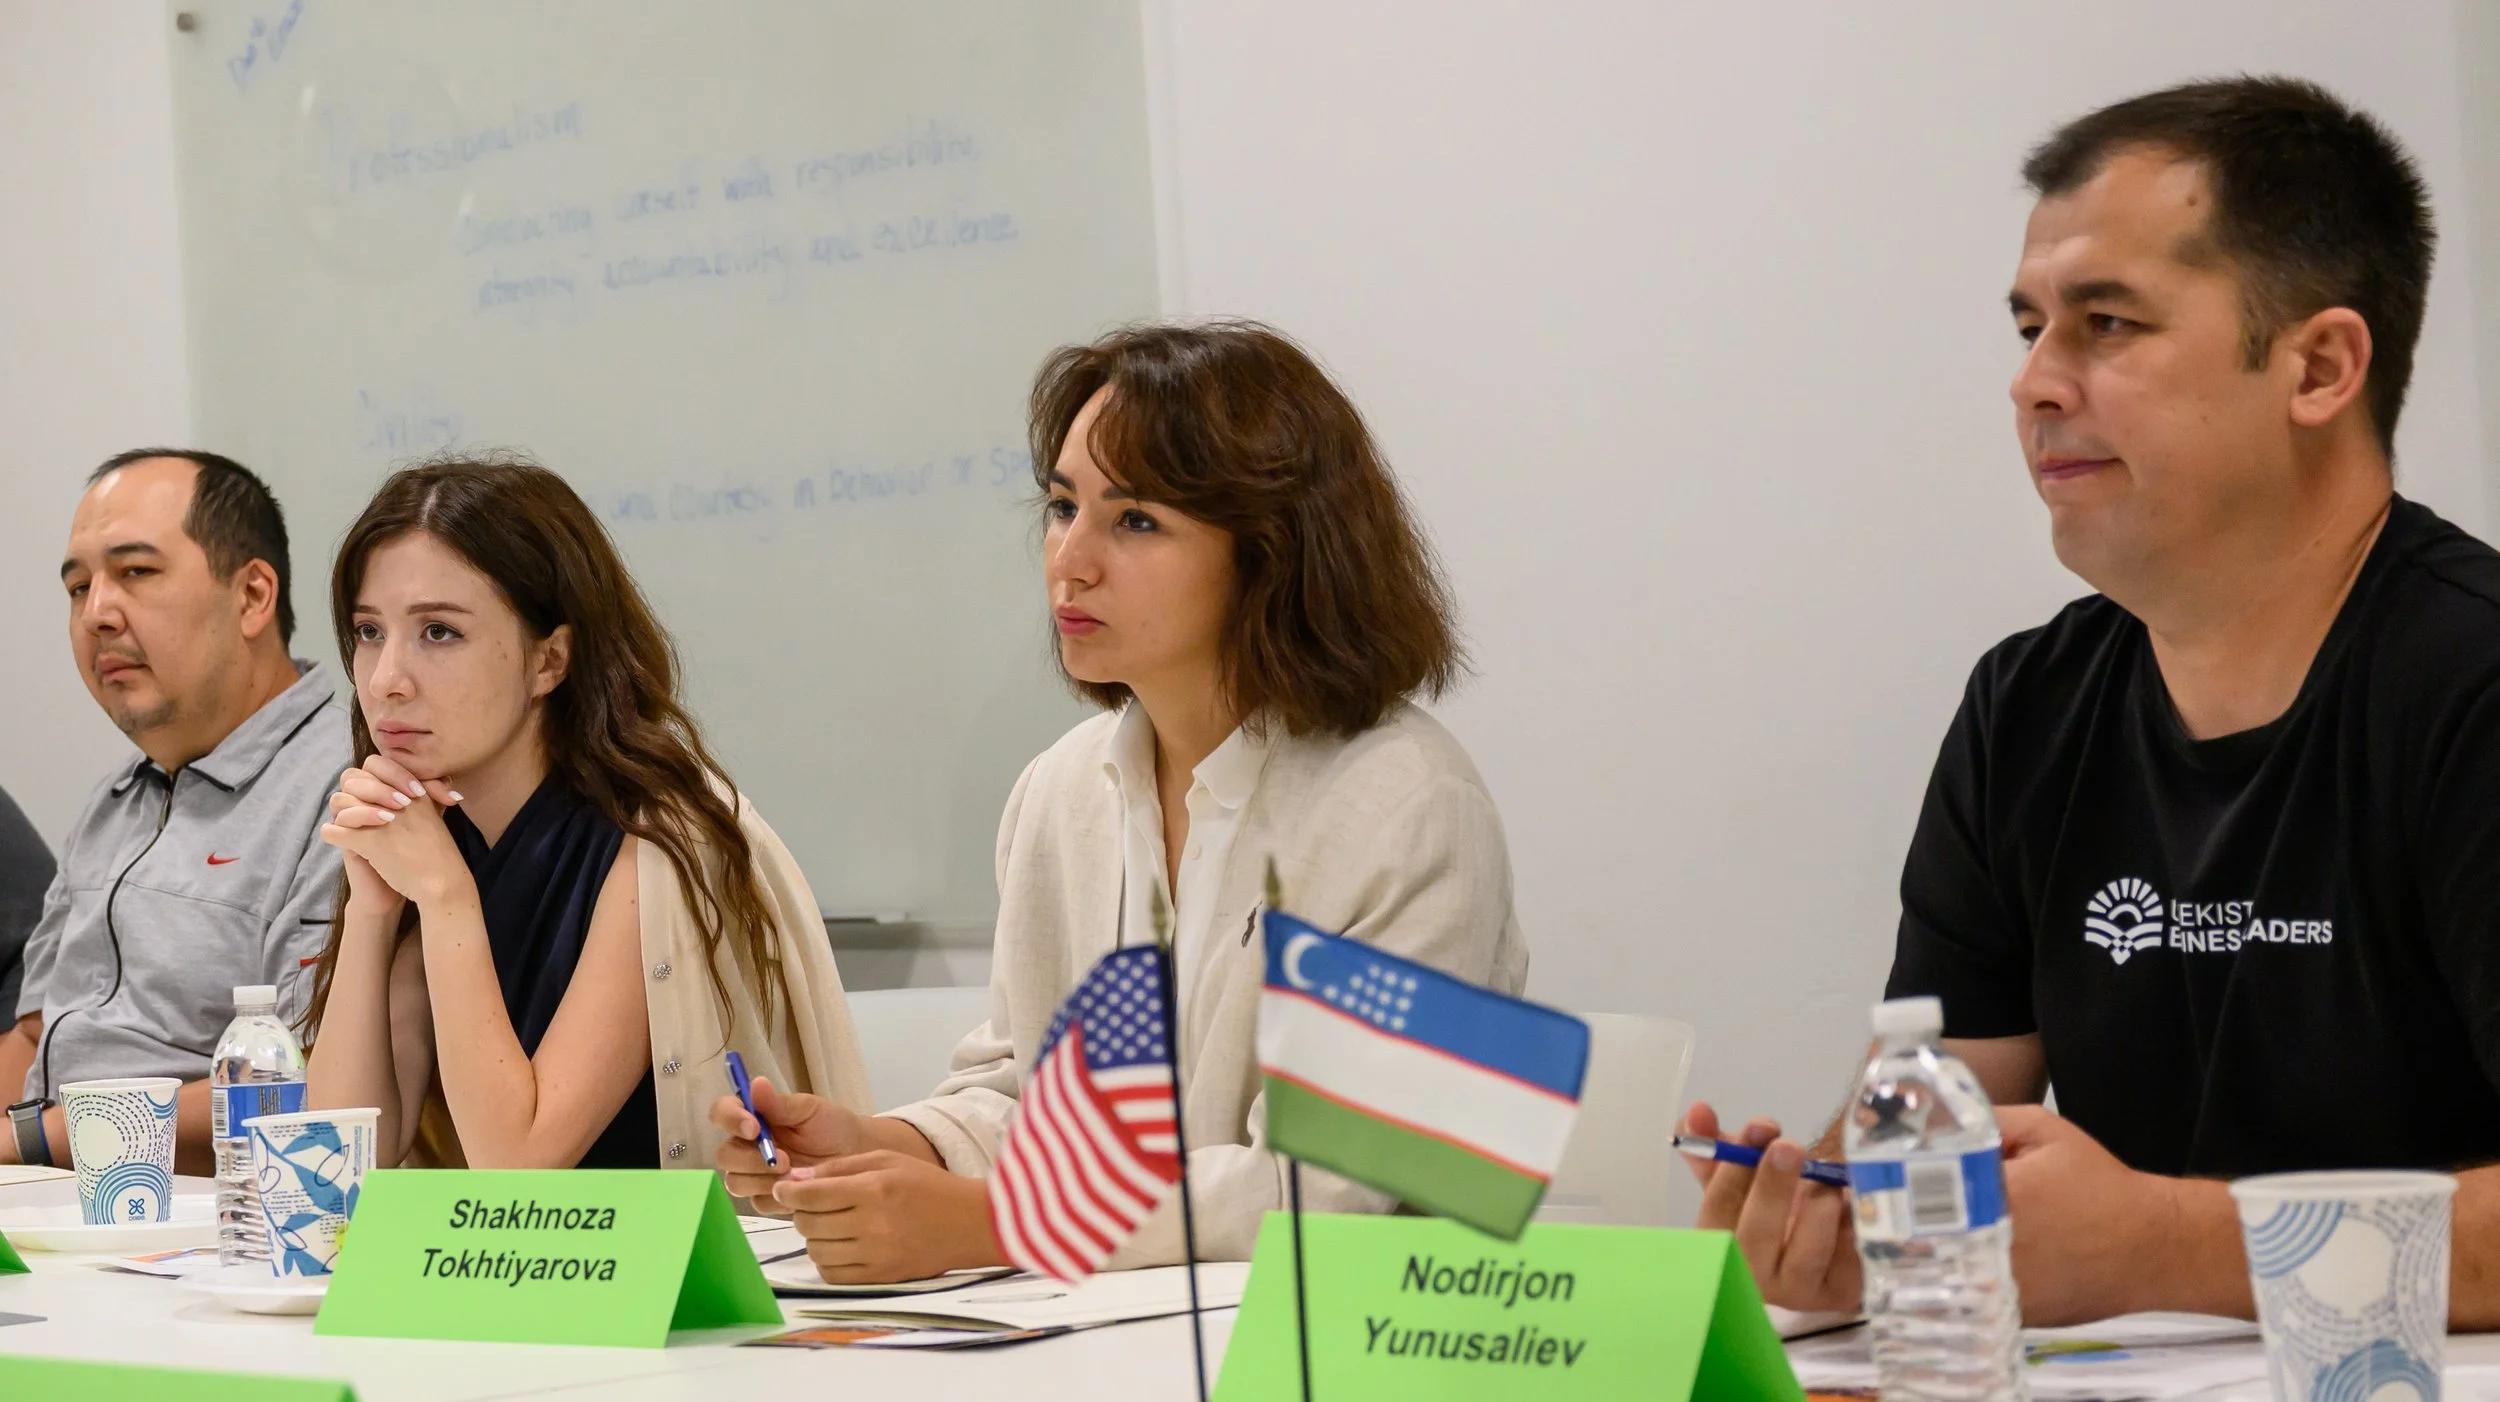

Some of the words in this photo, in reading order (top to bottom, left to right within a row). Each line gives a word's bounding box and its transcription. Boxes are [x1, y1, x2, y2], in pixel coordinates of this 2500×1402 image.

[449, 1199, 616, 1230] Shakhnoza
[422, 1248, 617, 1288] Tokhtiyarova
[1400, 1255, 1576, 1309] Nodirjon
[1364, 1315, 1588, 1368] Yunusaliev
